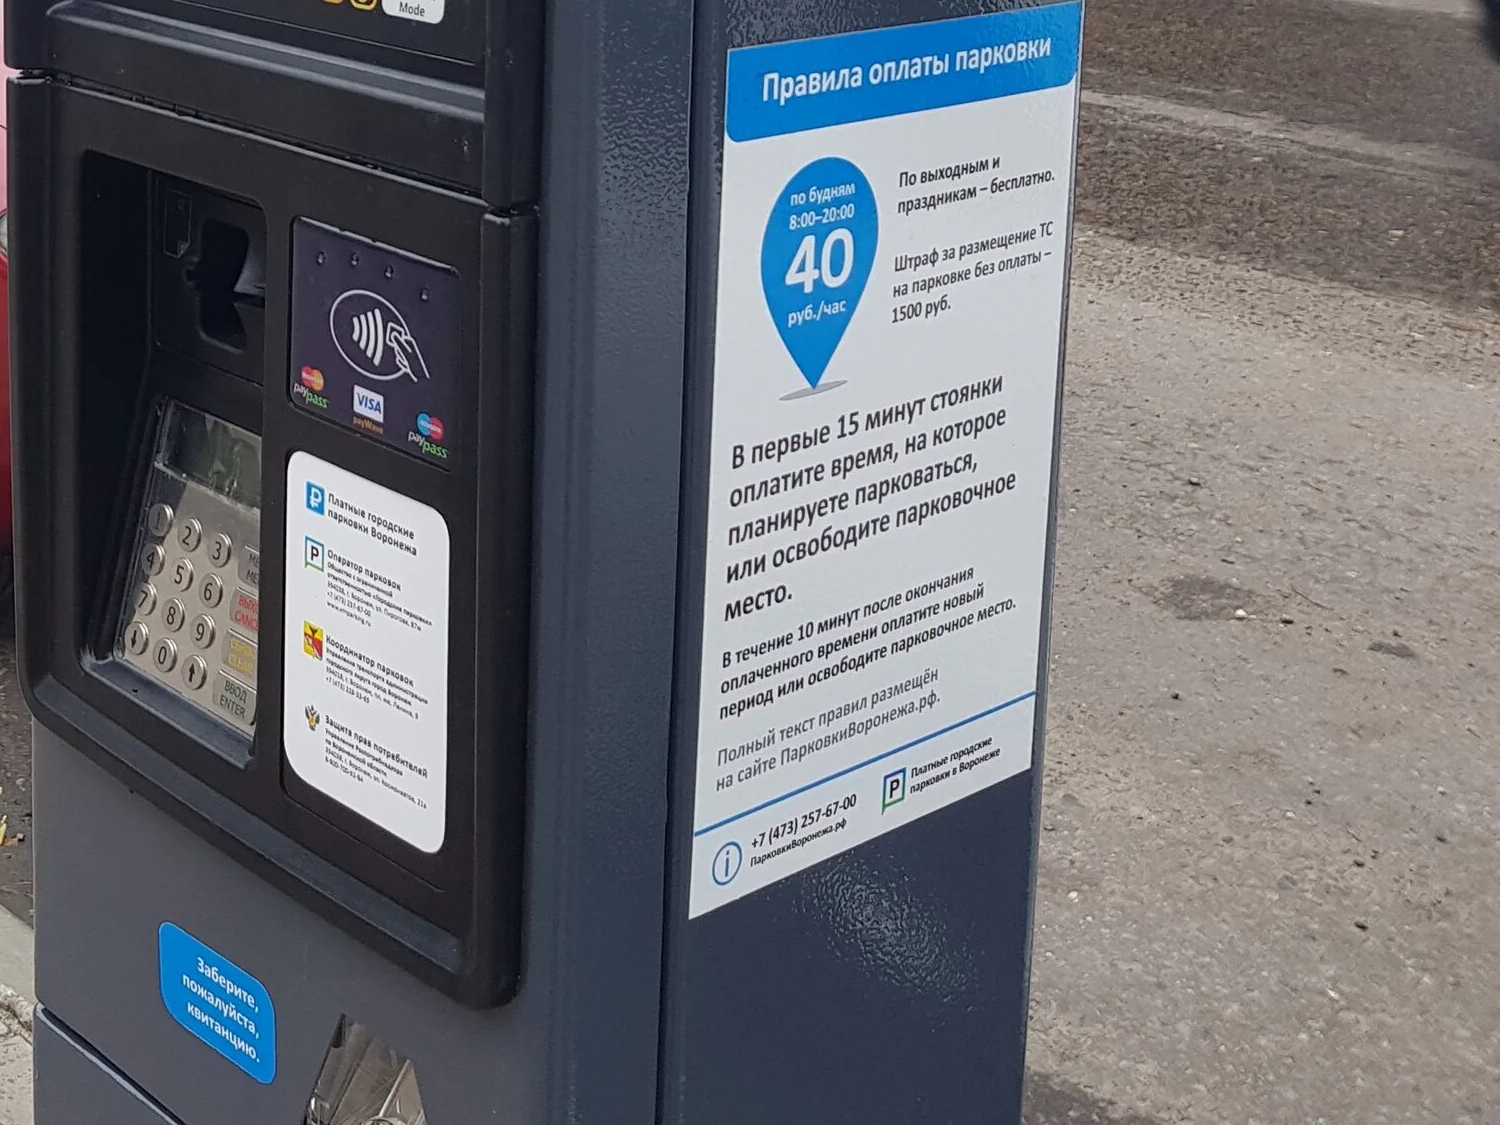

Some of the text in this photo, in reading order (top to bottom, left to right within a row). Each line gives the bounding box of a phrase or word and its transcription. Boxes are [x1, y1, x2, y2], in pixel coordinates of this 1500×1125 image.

[398, 2, 424, 19] Mode
[763, 37, 1051, 105] Правила оплаты парковки
[790, 183, 855, 206] по будням
[898, 171, 1054, 216] праздникам бесплатно.
[899, 157, 1000, 188] По выходным и
[785, 228, 854, 293] 40
[895, 221, 1053, 272] Штраф за размещение ТС
[893, 251, 1041, 298] на парковке без оплаты
[788, 300, 846, 328] руб./час
[892, 294, 951, 323] 1500 руб.
[294, 383, 329, 409] paypass
[358, 392, 382, 413] VISA
[408, 431, 448, 459] paypass
[732, 376, 1002, 469] В первые 15 минут стоянки
[730, 409, 1006, 507] оплатите время, на которое
[328, 493, 414, 540] Платные городские
[729, 453, 977, 546] планируете парковаться,
[182, 526, 191, 545] 2
[212, 541, 221, 560] 3
[328, 509, 417, 556] парковки Воронежа
[727, 473, 1016, 584] или освободите парковочное
[147, 552, 212, 601] 4 5 6
[328, 549, 401, 591] Оператор парковок
[139, 589, 204, 641] 7 8 9
[723, 567, 973, 668] В течение 10 минут после окончания
[724, 585, 792, 621] место.
[158, 646, 166, 665] 0
[326, 635, 413, 687] Координатор парковок
[720, 599, 1016, 720] период или освободите парковочное место.
[721, 582, 984, 694] оплаченного времени оплатите новый
[220, 694, 246, 719] ENTER
[225, 680, 247, 704] ВВОД
[716, 692, 940, 791] на сайте ПарковкиВоронежа.рф.
[718, 669, 938, 766] Полный текст правил размещён
[326, 715, 427, 778] Защита прав потребителей
[911, 737, 992, 778] Платные городские
[910, 748, 1000, 794] парковки в Воронеже
[750, 819, 847, 867] ПарковкиВоронежа.рф
[751, 794, 857, 848] +7 (473) 257-67-00
[183, 975, 259, 1039] пожалуйста,
[197, 957, 258, 1012] Заберите,
[188, 1002, 260, 1062] квитанцию.
